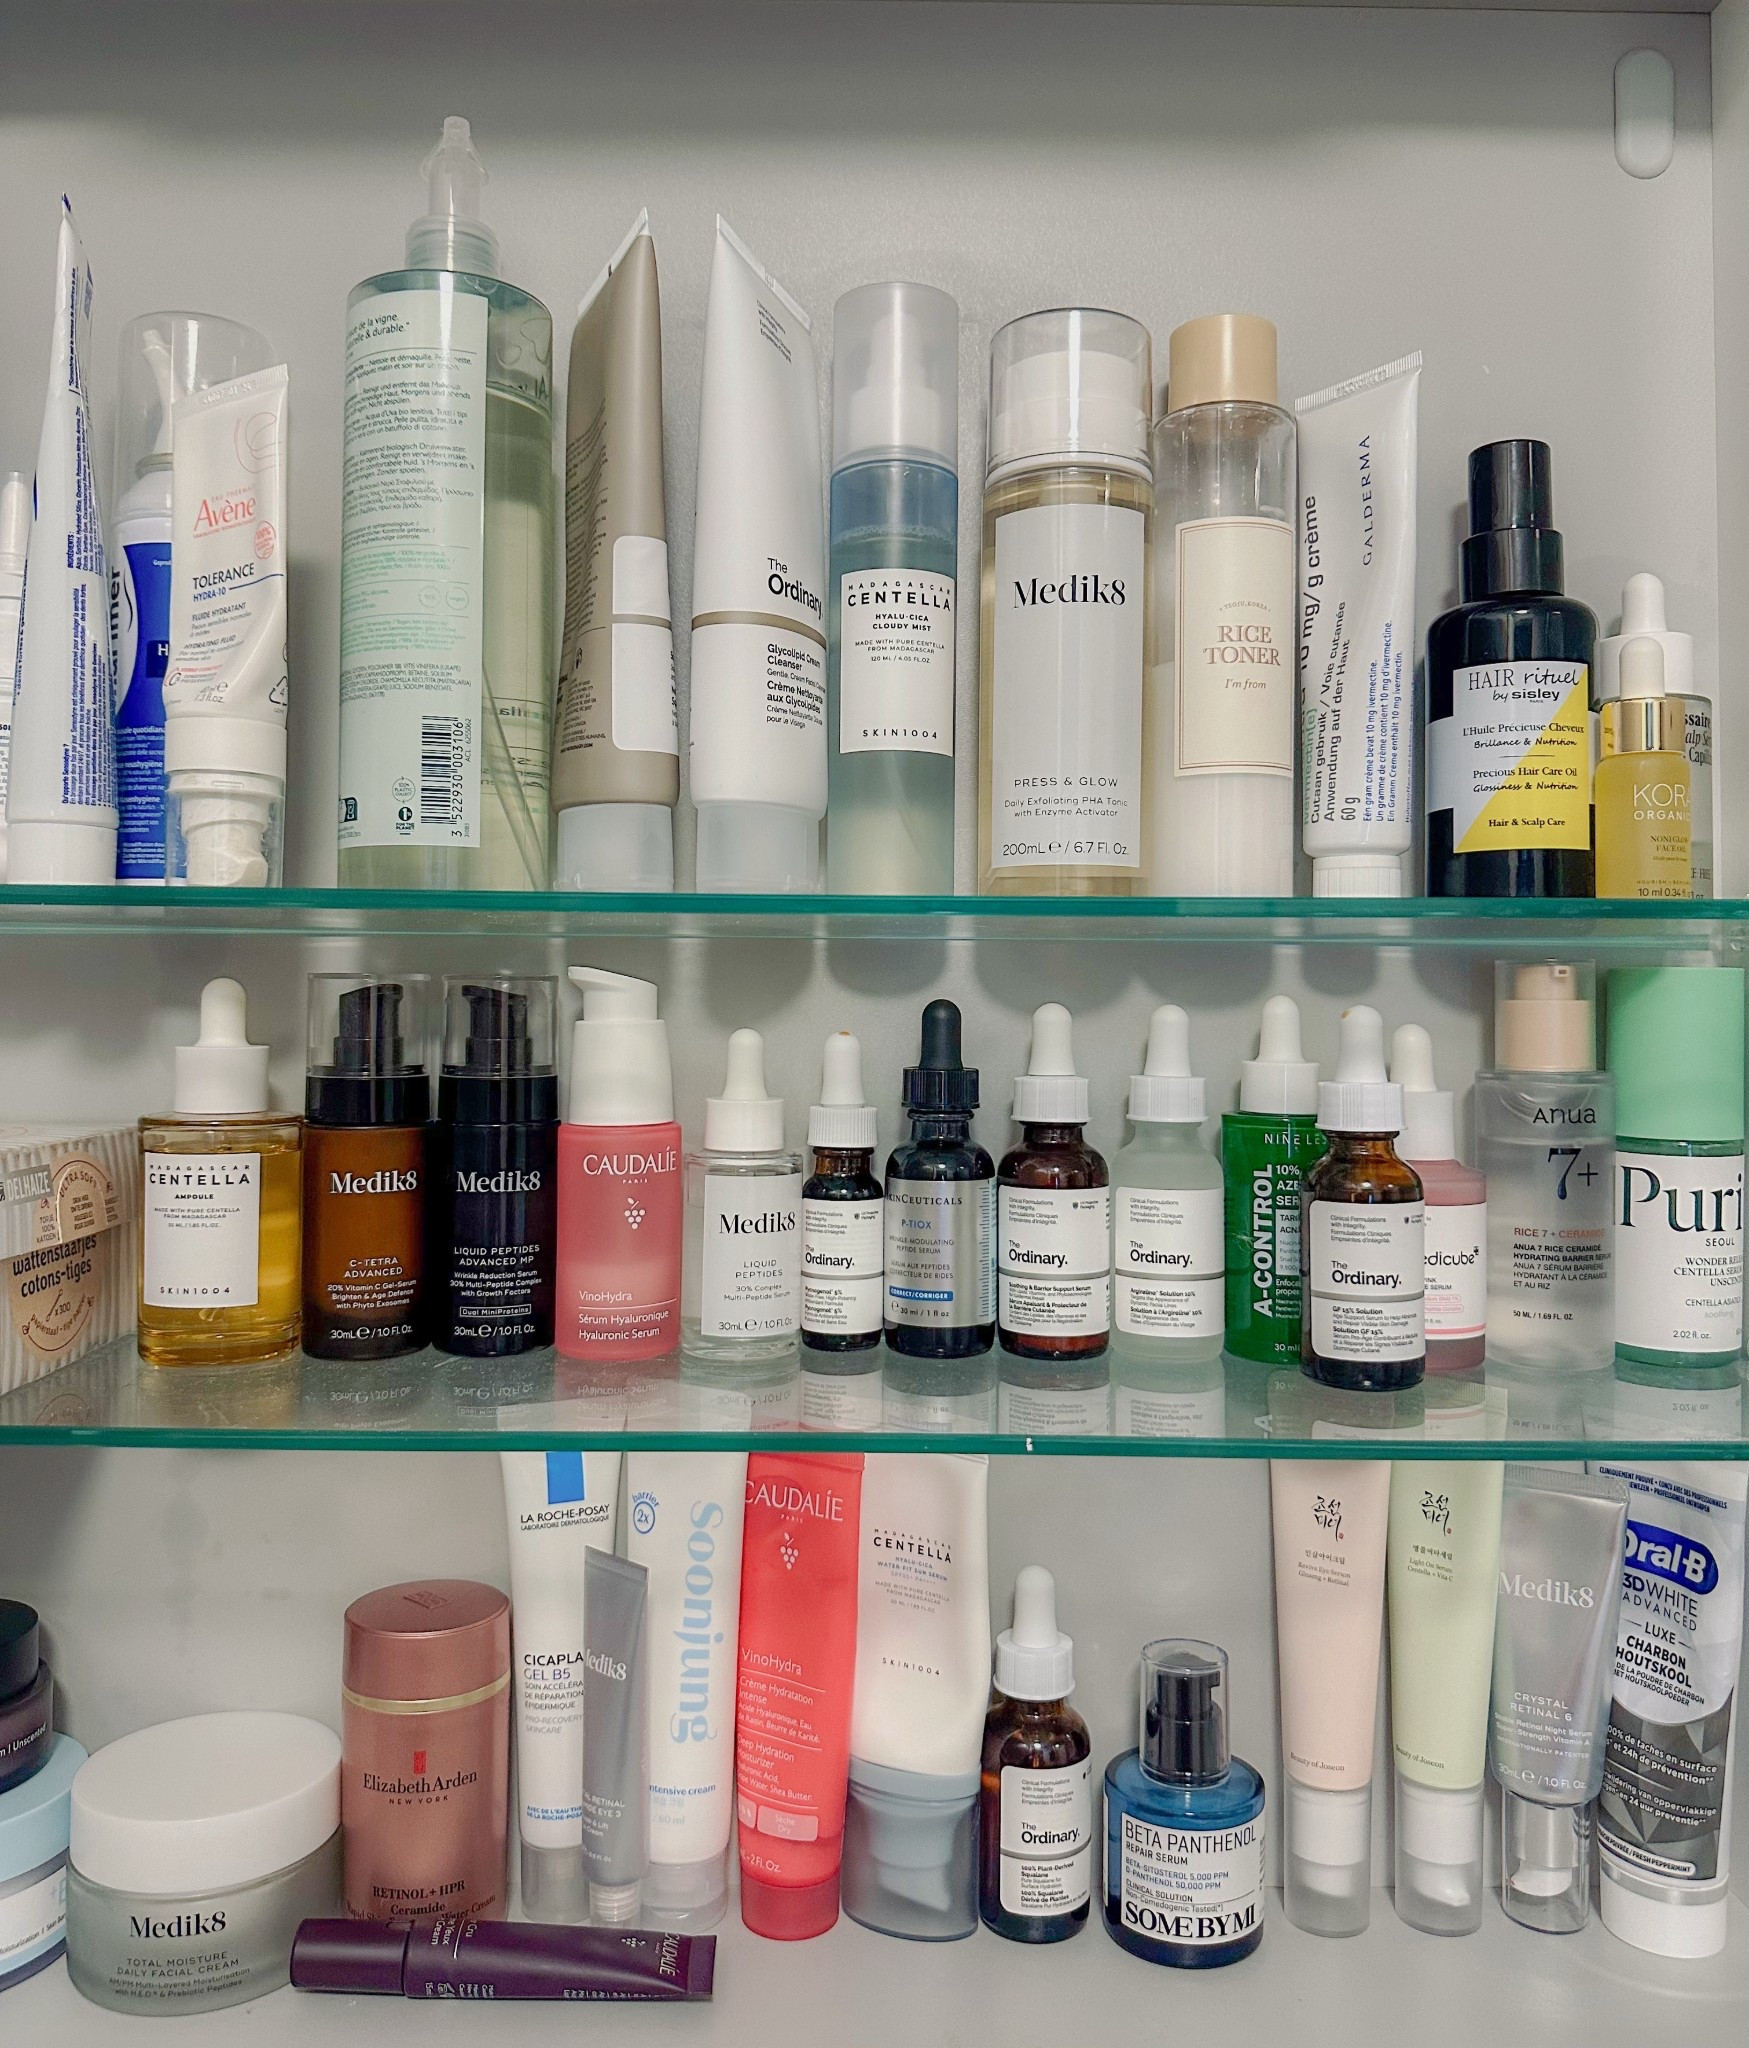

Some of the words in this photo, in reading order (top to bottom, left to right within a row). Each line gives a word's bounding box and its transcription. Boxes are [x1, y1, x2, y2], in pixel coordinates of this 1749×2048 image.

[375, 314, 399, 324] vigne.
[1359, 434, 1372, 566] GALDERMA
[194, 497, 257, 532] Avène
[1304, 495, 1320, 566] crème
[767, 558, 787, 573] The
[192, 563, 255, 590] TOLERANCE
[193, 587, 227, 602] HYDRA-10
[849, 581, 950, 595] MADAGASCAR
[1013, 574, 1126, 609] Medik8
[768, 574, 824, 620] Ordinary.
[848, 591, 950, 611] CENTELLA
[875, 613, 929, 622] HYALU-CICA
[1217, 624, 1272, 644] RICE
[1330, 601, 1346, 658] cutanée
[767, 643, 805, 661] Glycolipid
[890, 646, 934, 654] MADAGASCAR
[1203, 646, 1281, 667] TONER
[767, 656, 802, 671] Cleanser
[767, 680, 795, 694] Crème
[1243, 678, 1267, 690] from
[1321, 663, 1335, 695] Voie
[1468, 668, 1514, 691] HAIR
[1523, 667, 1580, 686] rituel
[767, 693, 783, 703] aux
[1493, 690, 1508, 702] by
[1511, 688, 1560, 701] sisley
[862, 729, 937, 739] SKIN1004
[1317, 711, 1327, 765] gebruik
[1324, 735, 1342, 822] Anwendung
[1337, 640, 1350, 669] Haut
[1463, 725, 1495, 737] L'Huile
[1498, 722, 1546, 733] Précieuse
[1549, 722, 1584, 734] Cheveux
[452, 722, 464, 768] 003106
[1474, 738, 1521, 749] Brillance
[1535, 737, 1577, 746] Nutrition
[1473, 767, 1515, 779] Precious
[1518, 766, 1539, 777] Hair
[1542, 767, 1563, 777] Care
[1014, 777, 1057, 788] PRESS
[1079, 777, 1118, 788] GLOW
[1473, 782, 1521, 793] Glossiness
[1536, 782, 1578, 791] Nutrition
[452, 775, 462, 820] 522930
[1005, 798, 1024, 808] Daily
[1028, 796, 1078, 807] Exfoliating
[1082, 796, 1103, 805] PHA
[1311, 770, 1322, 824] Cutaan
[1035, 808, 1072, 817] Enzyme
[1075, 807, 1118, 817] Activator
[1488, 818, 1508, 827] Hair
[1521, 817, 1545, 828] Scalp
[1547, 818, 1566, 827] Care
[1533, 1107, 1596, 1124] Anua
[583, 1146, 677, 1176] CAUDALÍE
[150, 1173, 250, 1186] CENTELLA
[330, 1171, 417, 1194] Medik8
[456, 1171, 541, 1193] Medik8
[1548, 1148, 1598, 1201] 7+
[7, 1171, 50, 1202] DELHAIZE
[719, 1211, 796, 1234] Medik8
[901, 1219, 931, 1229] P-TIOX
[1253, 1164, 1272, 1317] A-CONTROL
[1514, 1227, 1539, 1238] RICE
[454, 1247, 487, 1256] LIQUID
[491, 1245, 540, 1255] PEPTIDES
[1130, 1241, 1143, 1249] The
[1705, 1238, 1735, 1247] SEOUL
[350, 1257, 398, 1267] C-TETRA
[459, 1257, 517, 1266] ADVANCED
[520, 1256, 534, 1264] MP
[744, 1259, 776, 1268] LIQUID
[805, 1252, 855, 1269] Ordinary.
[1009, 1249, 1068, 1268] Ordinary.
[1130, 1249, 1193, 1268] Ordinary.
[1332, 1260, 1347, 1269] The
[1424, 1251, 1474, 1265] edicube
[1513, 1253, 1560, 1262] HYDRATING
[1562, 1254, 1594, 1262] BARRIER
[1685, 1257, 1728, 1266] WONDER
[21, 1258, 92, 1298] cotons-tiges
[344, 1267, 402, 1278] ADVANCED
[735, 1269, 783, 1279] PEPTIDES
[1332, 1270, 1401, 1288] Ordinary.
[1673, 1267, 1724, 1277] CENTELLA
[160, 1287, 231, 1295] SKIN1004
[332, 1293, 362, 1302] Brighten
[579, 1291, 632, 1302] VinoHydra
[55, 1302, 71, 1317] x300
[579, 1312, 608, 1325] Sérum
[610, 1310, 669, 1325] Hyaluronique
[579, 1330, 629, 1340] Hyaluronic
[632, 1328, 660, 1339] Serum
[520, 1514, 534, 1524] LA
[537, 1504, 610, 1522] ROCHE-POSAY
[874, 1536, 952, 1563] CENTELLA
[1498, 1571, 1594, 1609] Medik8
[1623, 1592, 1697, 1631] ADVANCED
[1645, 1621, 1676, 1645] LUXE
[1626, 1635, 1686, 1669] CHARBON
[742, 1647, 802, 1676] VinoHydra
[882, 1657, 940, 1675] SKIN1004
[1616, 1646, 1692, 1688] HOUTSKOOL
[524, 1669, 548, 1680] GEL
[553, 1668, 571, 1680] B5
[740, 1676, 766, 1691] Crème
[769, 1683, 813, 1705] Hydratation
[1514, 1692, 1568, 1710] CRYSTAL
[1510, 1702, 1560, 1720] RETINAL
[11, 1722, 47, 1757] Unscented
[363, 1772, 431, 1794] Elizabeth
[433, 1771, 477, 1791] Arden
[1021, 1822, 1036, 1831] The
[1021, 1828, 1080, 1845] Ordinary.
[1126, 1820, 1162, 1849] BETA
[1168, 1825, 1256, 1854] PANTHENOL
[1126, 1841, 1153, 1858] REPAIR
[1156, 1852, 1188, 1865] SERUM
[391, 1902, 445, 1915] Ceramide
[130, 1910, 227, 1940] Medik8
[127, 1957, 162, 1967] TOTAL
[166, 1950, 228, 1966] MOISTURE
[117, 1966, 147, 1977] DAILY
[151, 1967, 193, 1978] FACIAL
[198, 1958, 239, 1975] CREAM
